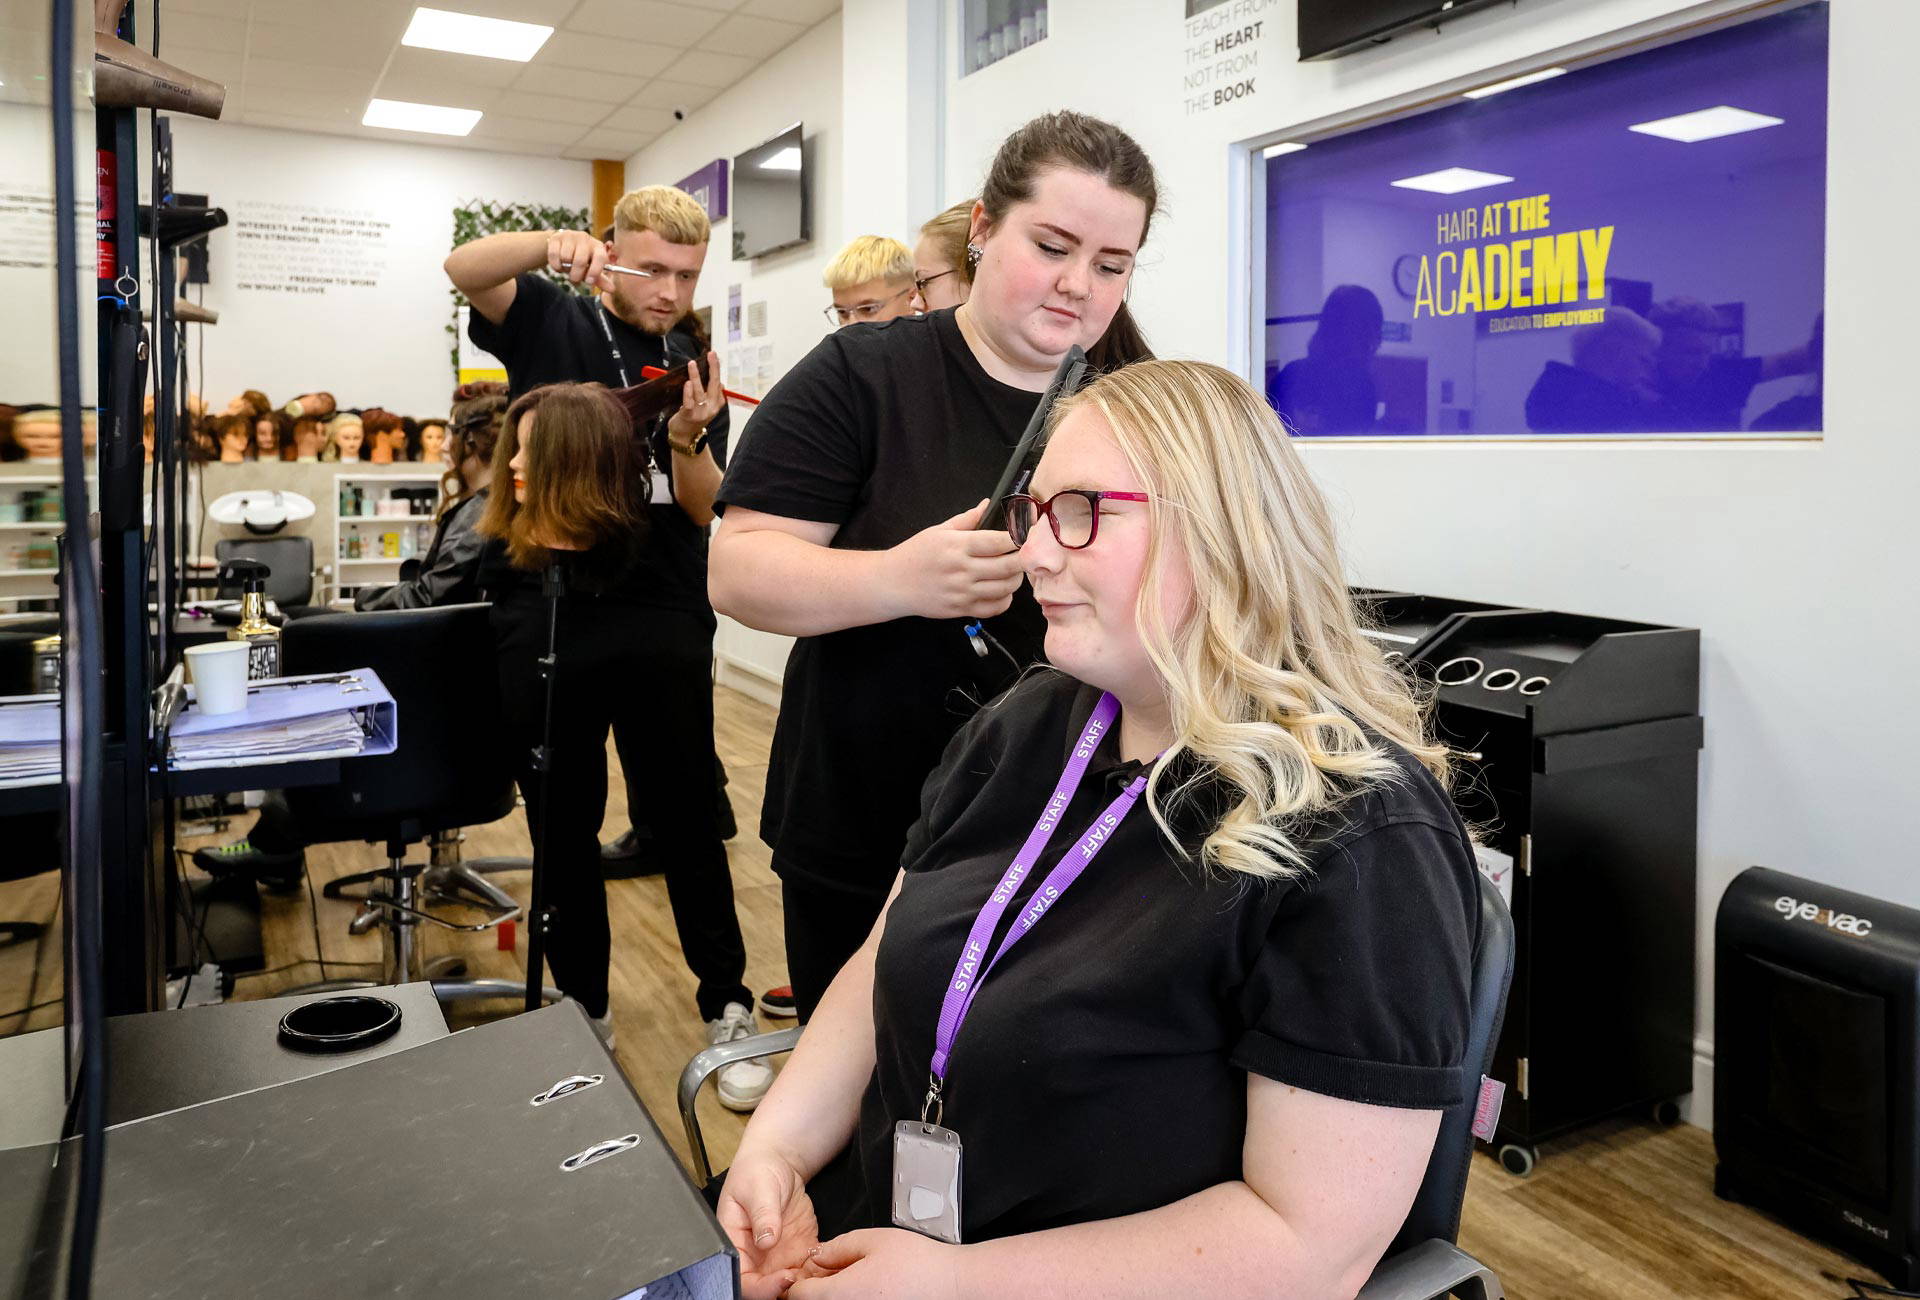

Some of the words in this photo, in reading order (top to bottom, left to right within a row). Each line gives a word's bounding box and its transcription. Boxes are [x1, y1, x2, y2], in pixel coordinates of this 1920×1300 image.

[1184, 7, 1230, 39] TEACH
[1184, 41, 1211, 65] THE
[1184, 66, 1212, 92] NOT
[1216, 50, 1258, 80] FROM
[1184, 92, 1210, 116] THE
[1214, 77, 1256, 106] BOOK
[313, 227, 353, 236] DEVELOP
[1437, 208, 1478, 244] HAIR
[1481, 203, 1504, 238] AT
[1506, 194, 1550, 233] THE
[1413, 225, 1615, 319] ACADEMY
[1543, 308, 1605, 328] EMPLOYMENT
[1077, 719, 1105, 759] STAFF
[1039, 790, 1068, 832] STAFF
[1082, 814, 1117, 859] STAFF
[993, 863, 1025, 904] STAFF
[1022, 885, 1058, 930] STAFF
[955, 940, 982, 992] STAFF
